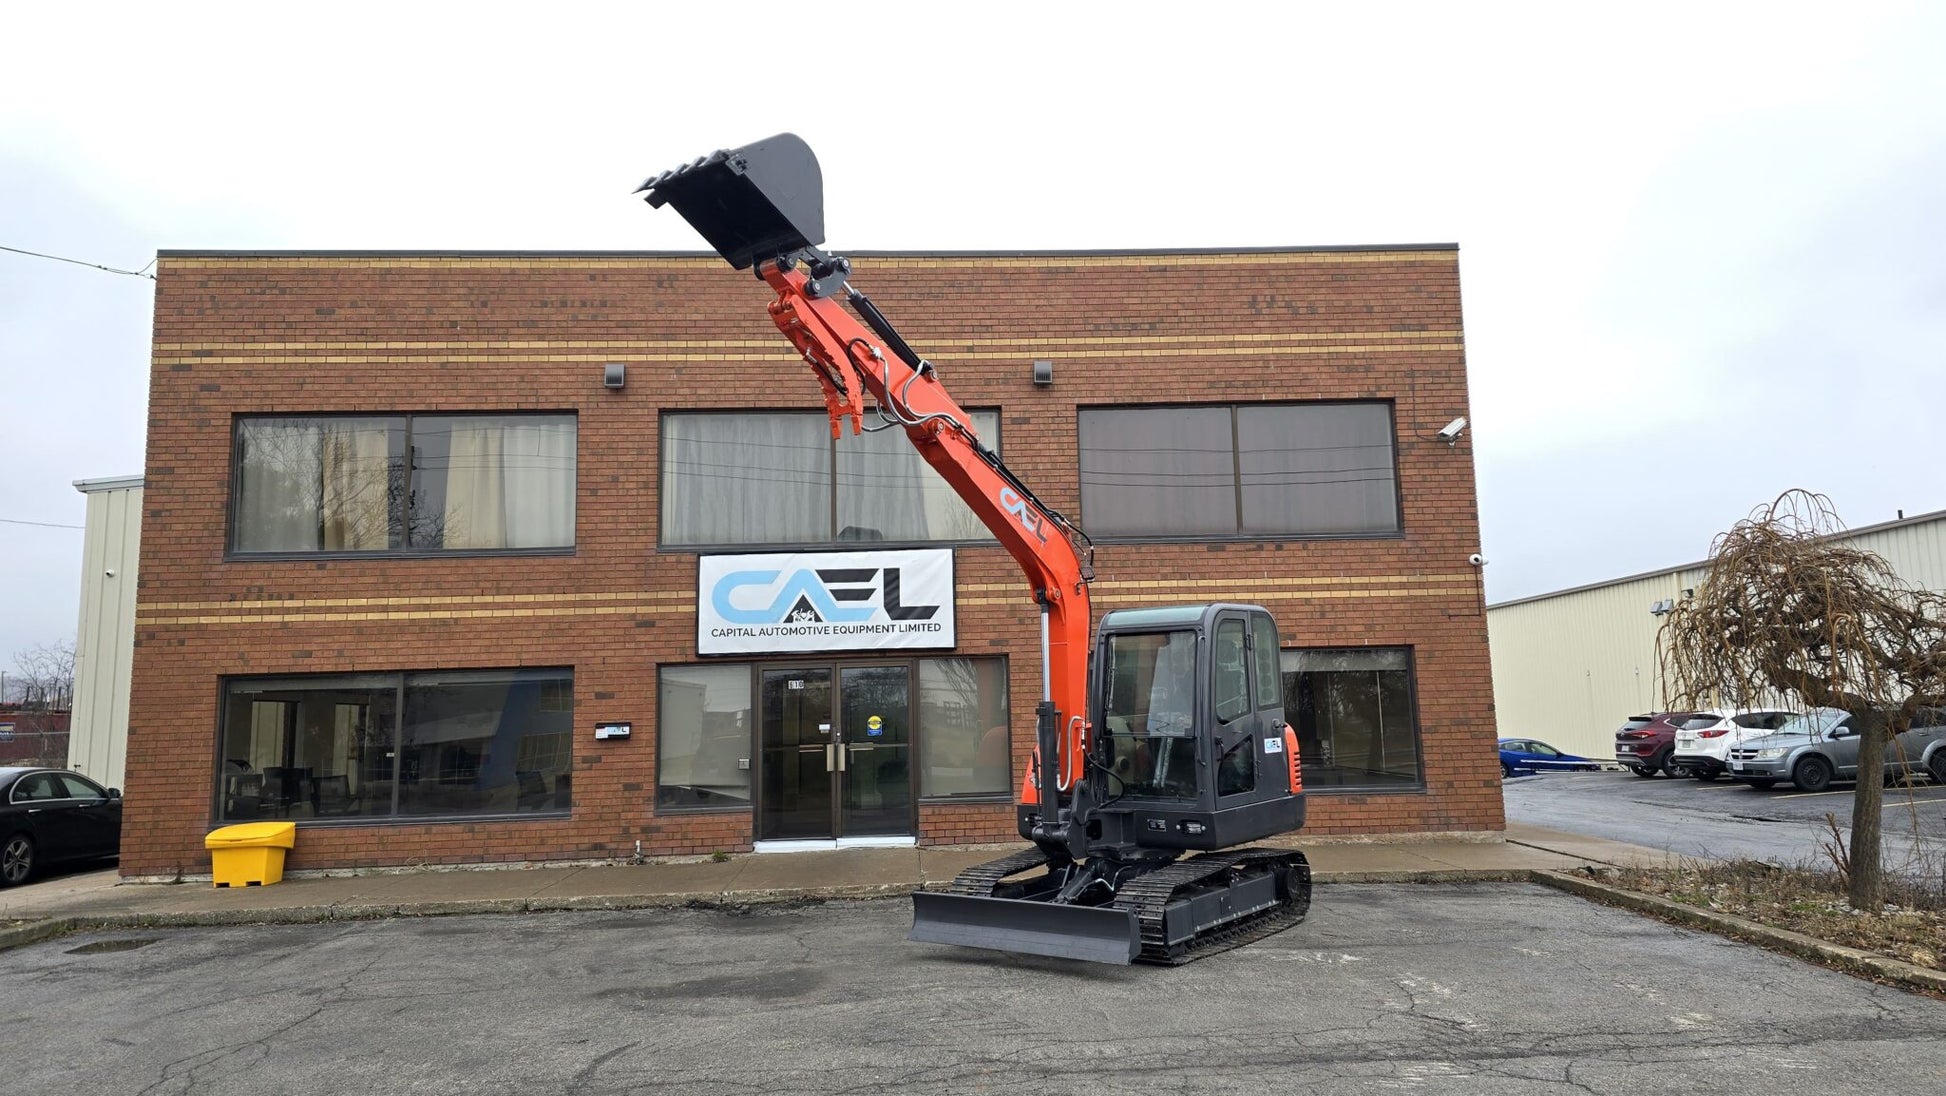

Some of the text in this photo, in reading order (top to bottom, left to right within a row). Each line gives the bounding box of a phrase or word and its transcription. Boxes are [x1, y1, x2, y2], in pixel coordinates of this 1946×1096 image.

[1000, 487, 1047, 543] CAEL
[711, 567, 940, 624] CAEL
[711, 622, 942, 638] CAPITAL AUTOMOTIVE EQUIPMENT LIMITED
